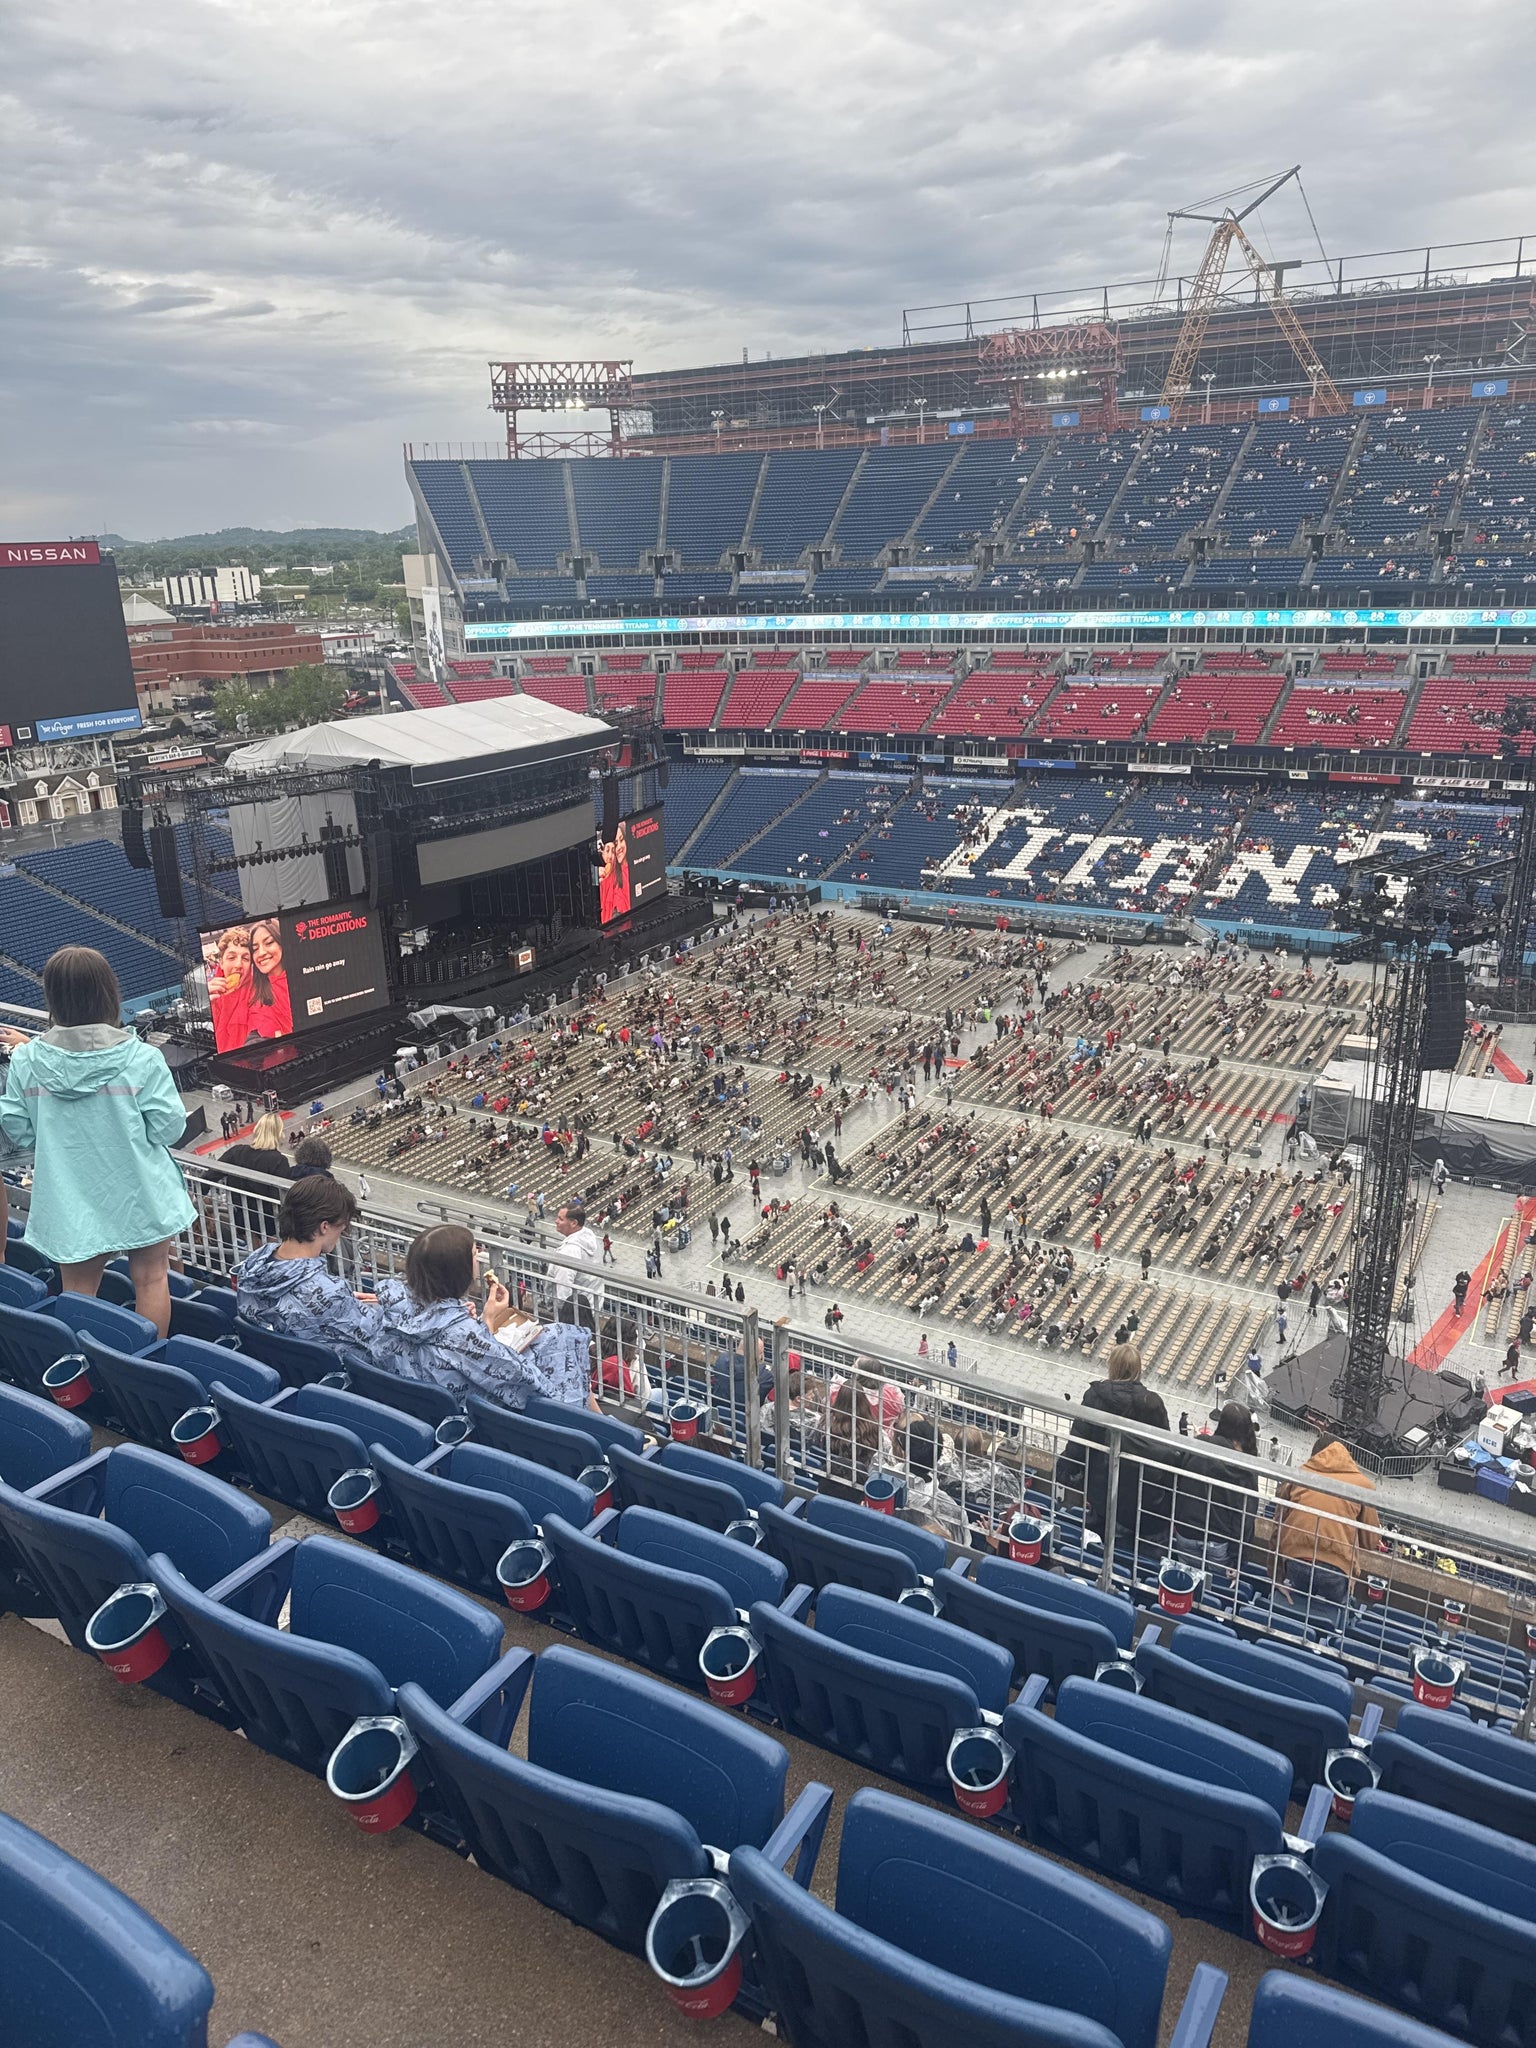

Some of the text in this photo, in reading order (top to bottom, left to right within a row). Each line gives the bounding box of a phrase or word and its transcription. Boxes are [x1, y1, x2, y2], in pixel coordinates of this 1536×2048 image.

[8, 548, 86, 561] NISSAN
[996, 616, 1023, 625] COFFEE
[1024, 616, 1057, 624] PARTNER
[1086, 615, 1131, 624] TENNESSEE
[1132, 615, 1160, 624] TITANS
[465, 626, 496, 636] OFFICIAL
[584, 622, 624, 631] TENNESSEE
[624, 622, 649, 630] TITANS
[51, 721, 73, 735] Kroger
[76, 721, 94, 729] FRESH
[95, 719, 106, 727] FOR
[921, 803, 1431, 917] TITANS
[308, 911, 352, 927] THE ROMANTIC
[308, 916, 367, 940] DEDICATIONS
[302, 959, 345, 974] Rain rain go away
[466, 1331, 491, 1351] POLER
[1482, 1437, 1497, 1448] ICE
[1424, 1693, 1448, 1703] Coca-Cola
